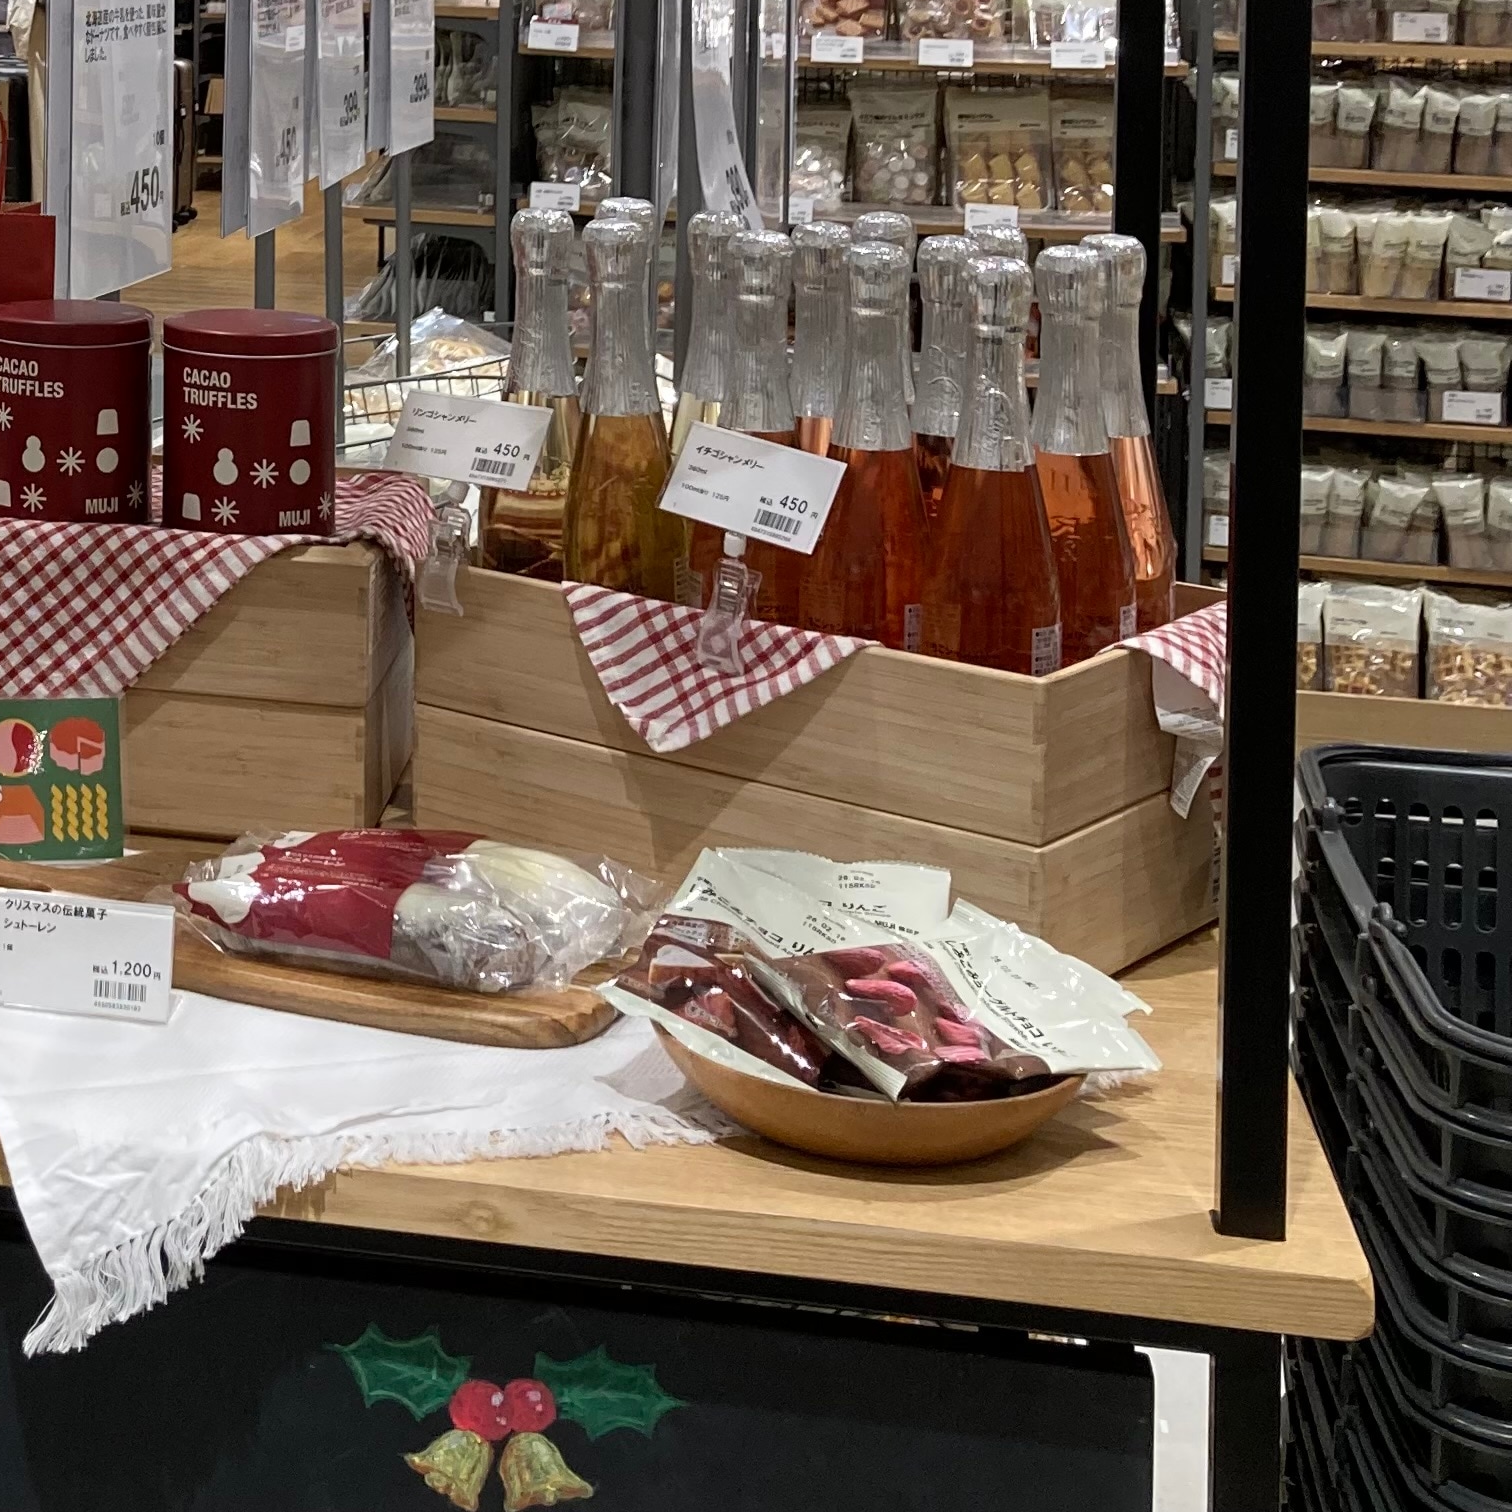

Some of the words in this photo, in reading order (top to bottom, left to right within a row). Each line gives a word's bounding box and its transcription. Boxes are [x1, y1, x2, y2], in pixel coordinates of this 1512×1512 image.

[183, 367, 231, 388] CACAO
[183, 387, 258, 410] TRUFFLES
[412, 408, 477, 424] リンゴシャンメリー
[493, 443, 521, 458] 450
[695, 445, 765, 471] イチゴシャンメリー
[85, 496, 119, 515] MUJI
[779, 495, 808, 514] 450
[278, 509, 311, 528] MUJI
[4, 898, 108, 921] クリスマスの伝統菓子
[4, 918, 57, 934] シュトーレン
